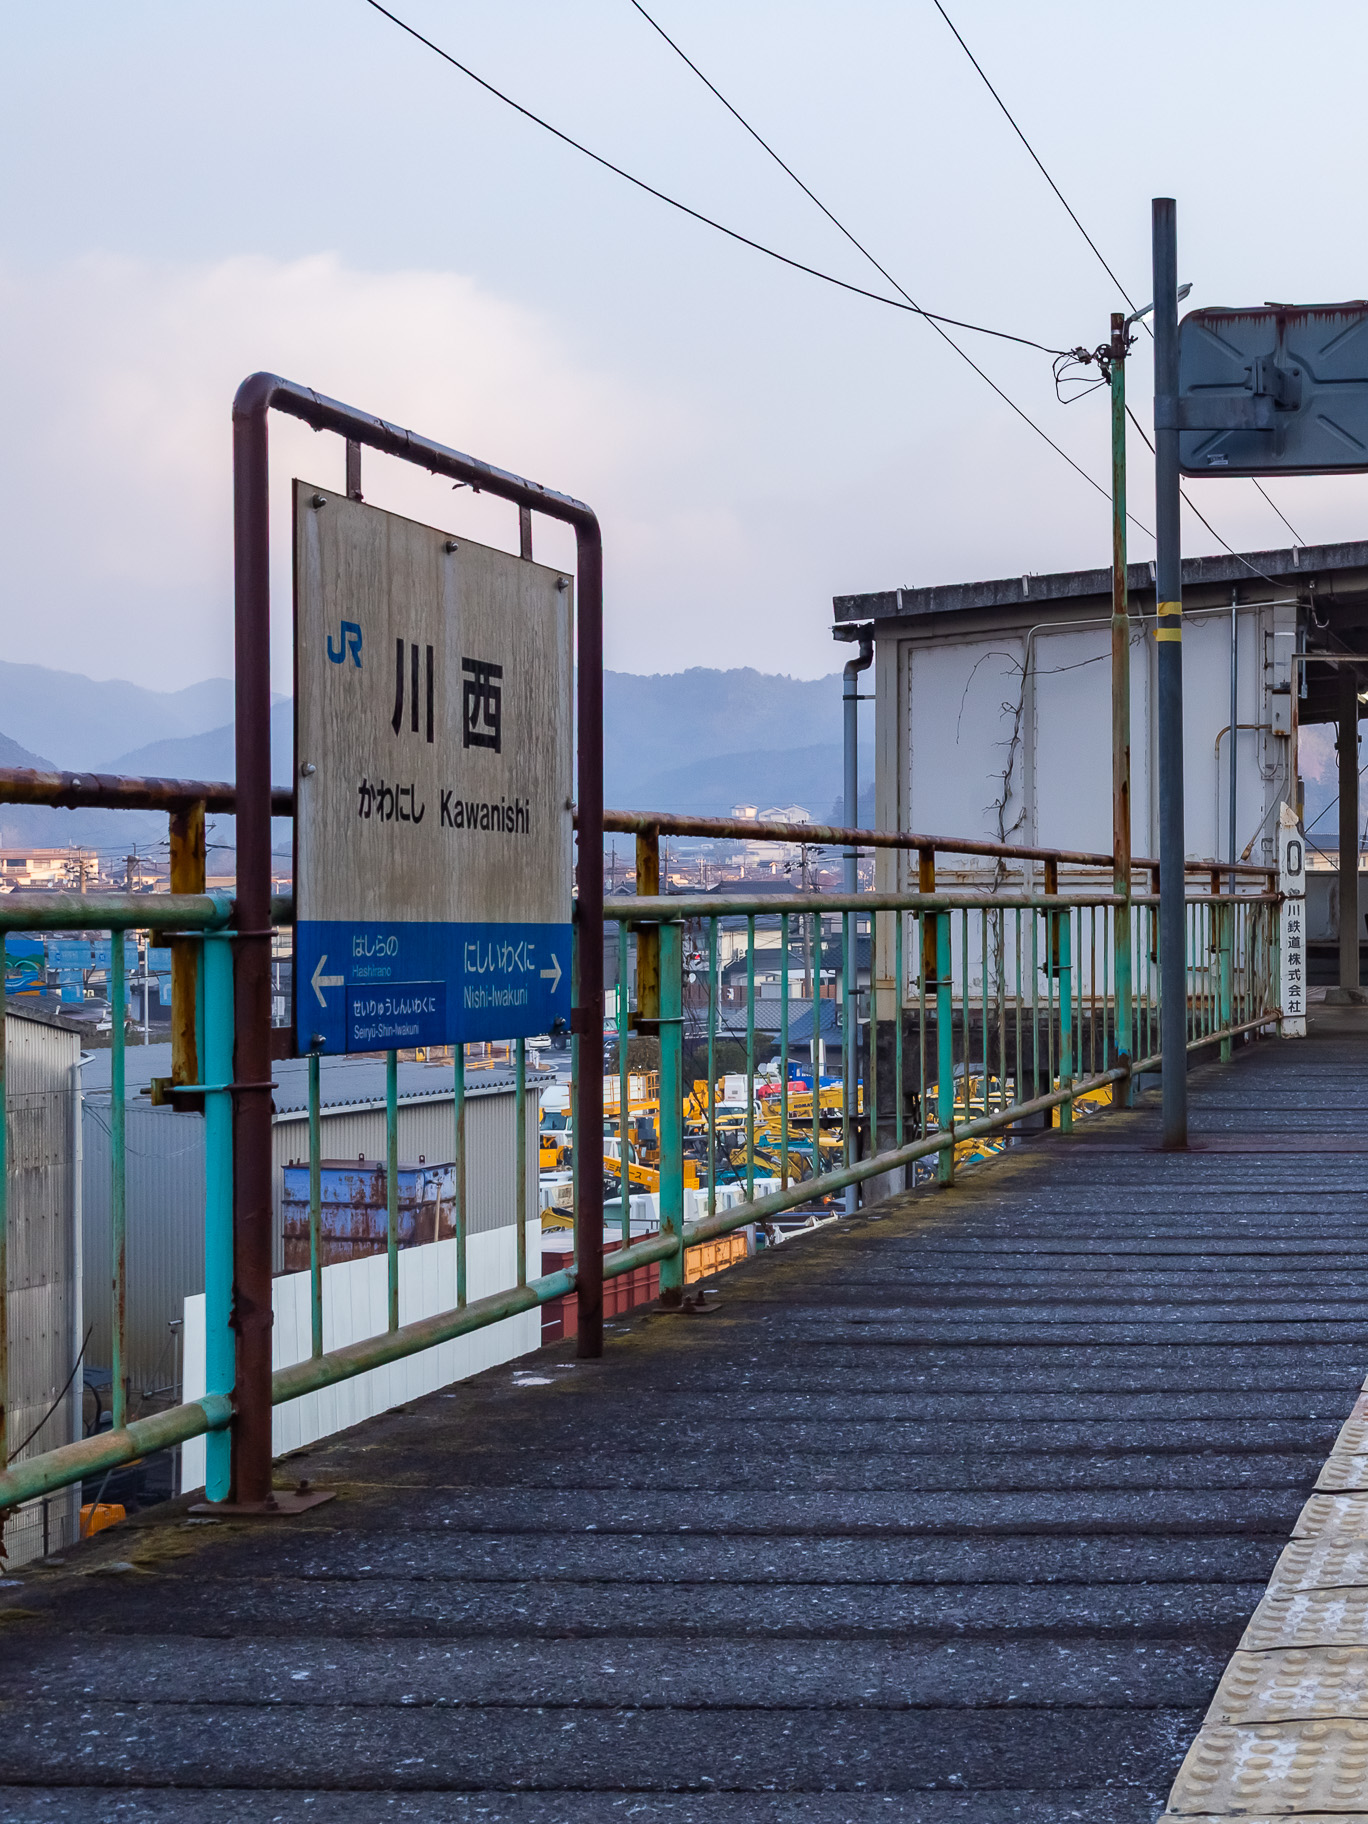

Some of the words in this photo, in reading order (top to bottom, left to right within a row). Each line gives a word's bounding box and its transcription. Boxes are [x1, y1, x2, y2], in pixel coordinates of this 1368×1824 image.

[327, 620, 363, 669] JR
[391, 637, 503, 754] 川西
[358, 778, 425, 824] かわにし
[440, 789, 530, 834] Kawanishi
[352, 934, 399, 957] はしらの
[464, 940, 535, 974] にしいわくに
[352, 964, 392, 977] Hashirano
[353, 996, 436, 1017] せいりゅうしんいわくに
[464, 983, 528, 1009] Nishi-Iwakuni
